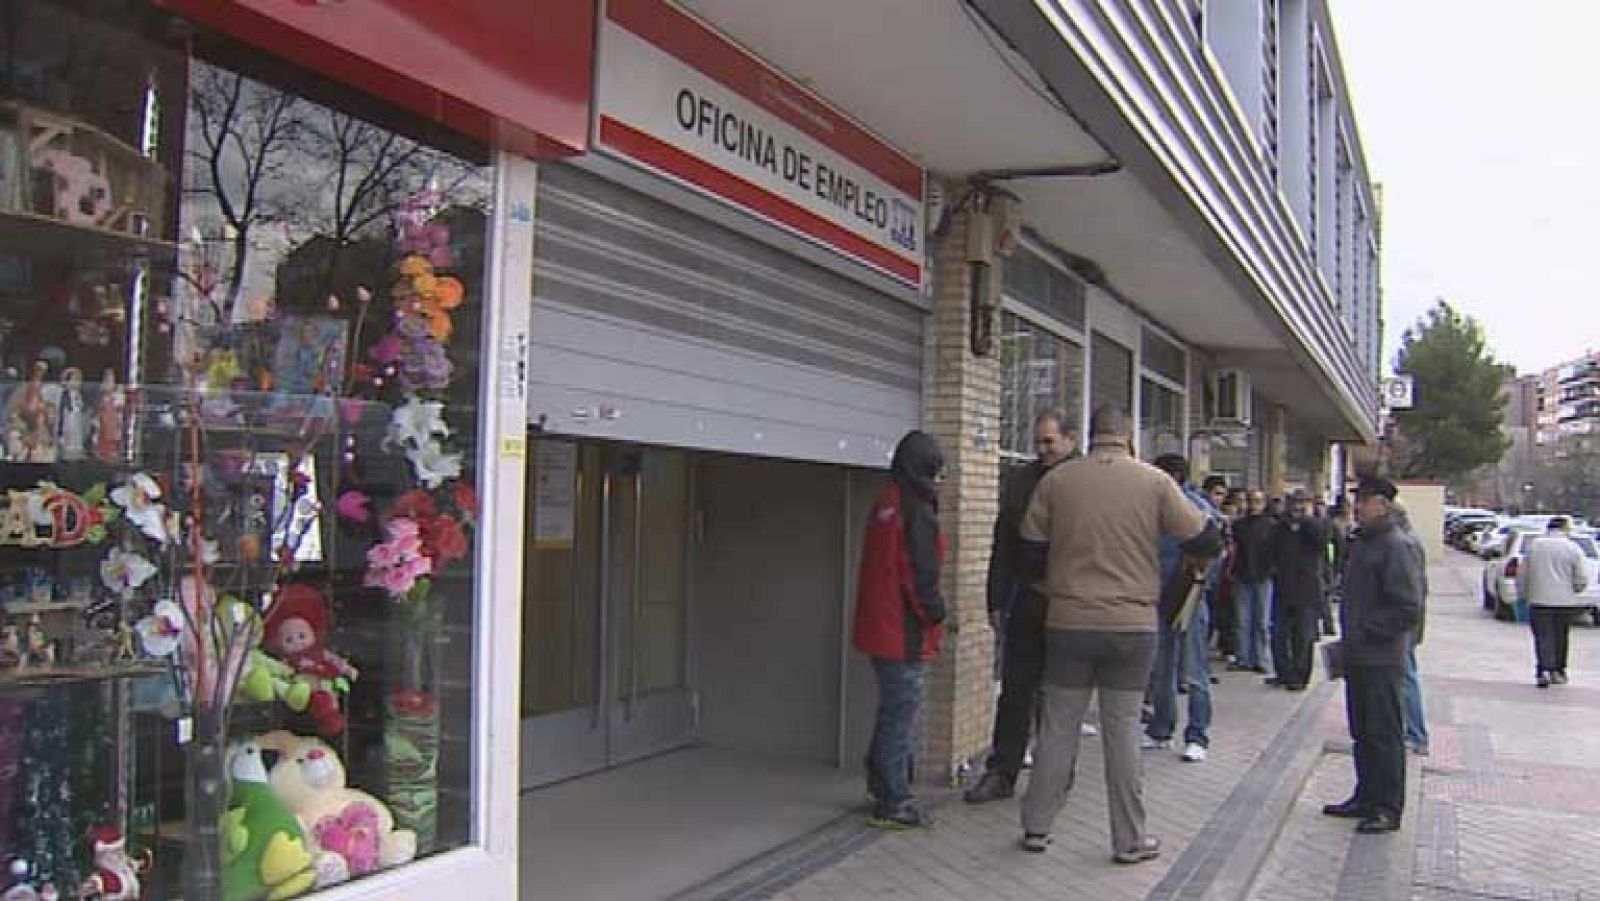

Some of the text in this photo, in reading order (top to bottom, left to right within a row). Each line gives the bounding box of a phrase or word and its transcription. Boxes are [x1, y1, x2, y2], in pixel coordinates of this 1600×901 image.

[676, 88, 777, 173] OFICINA
[783, 146, 811, 190] DE
[815, 166, 887, 229] EMPLEO
